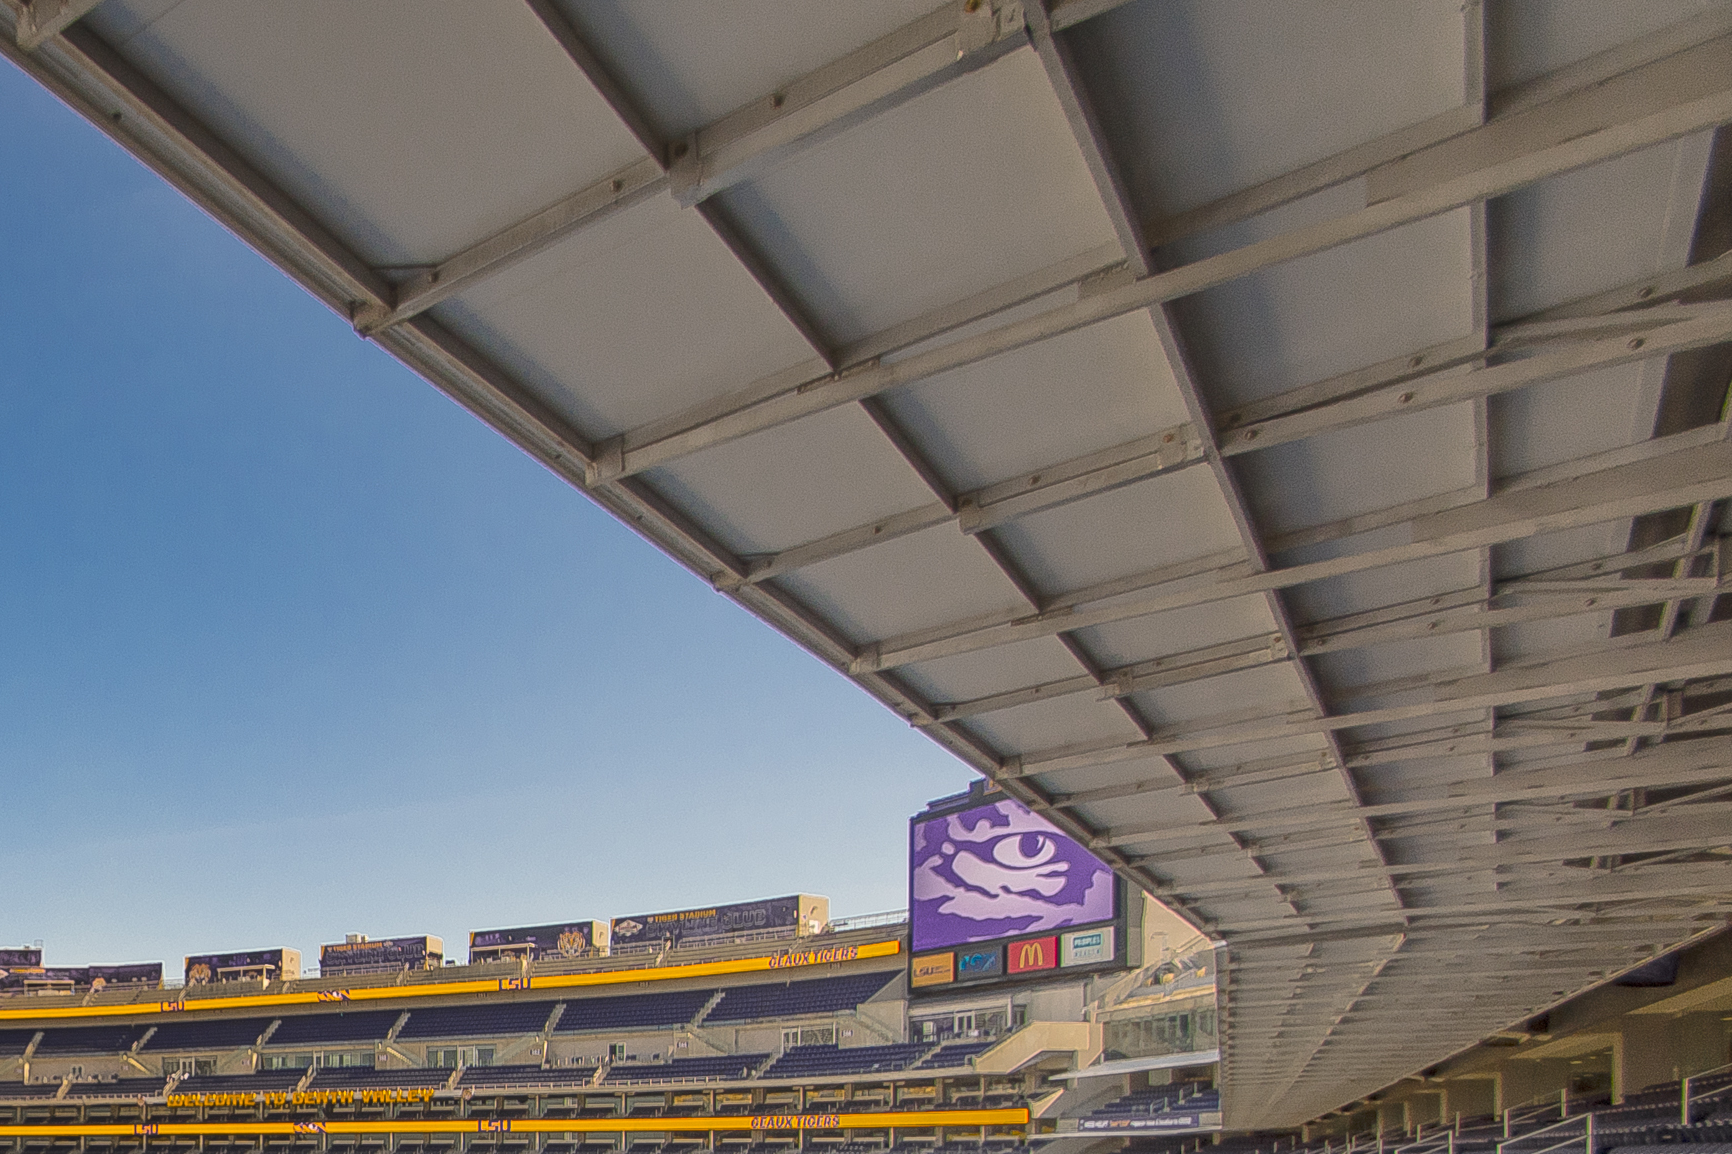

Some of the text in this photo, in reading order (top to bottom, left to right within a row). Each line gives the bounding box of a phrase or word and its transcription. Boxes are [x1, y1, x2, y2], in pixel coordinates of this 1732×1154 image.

[679, 909, 717, 920] STADIUM
[768, 946, 858, 969] GEAUX TIGERS
[499, 977, 531, 991] LSU
[167, 1089, 435, 1107] WELCOME TO DEATH VALLEY
[479, 1119, 512, 1133] LSU
[751, 1115, 840, 1129] GEAUX TIGERS
